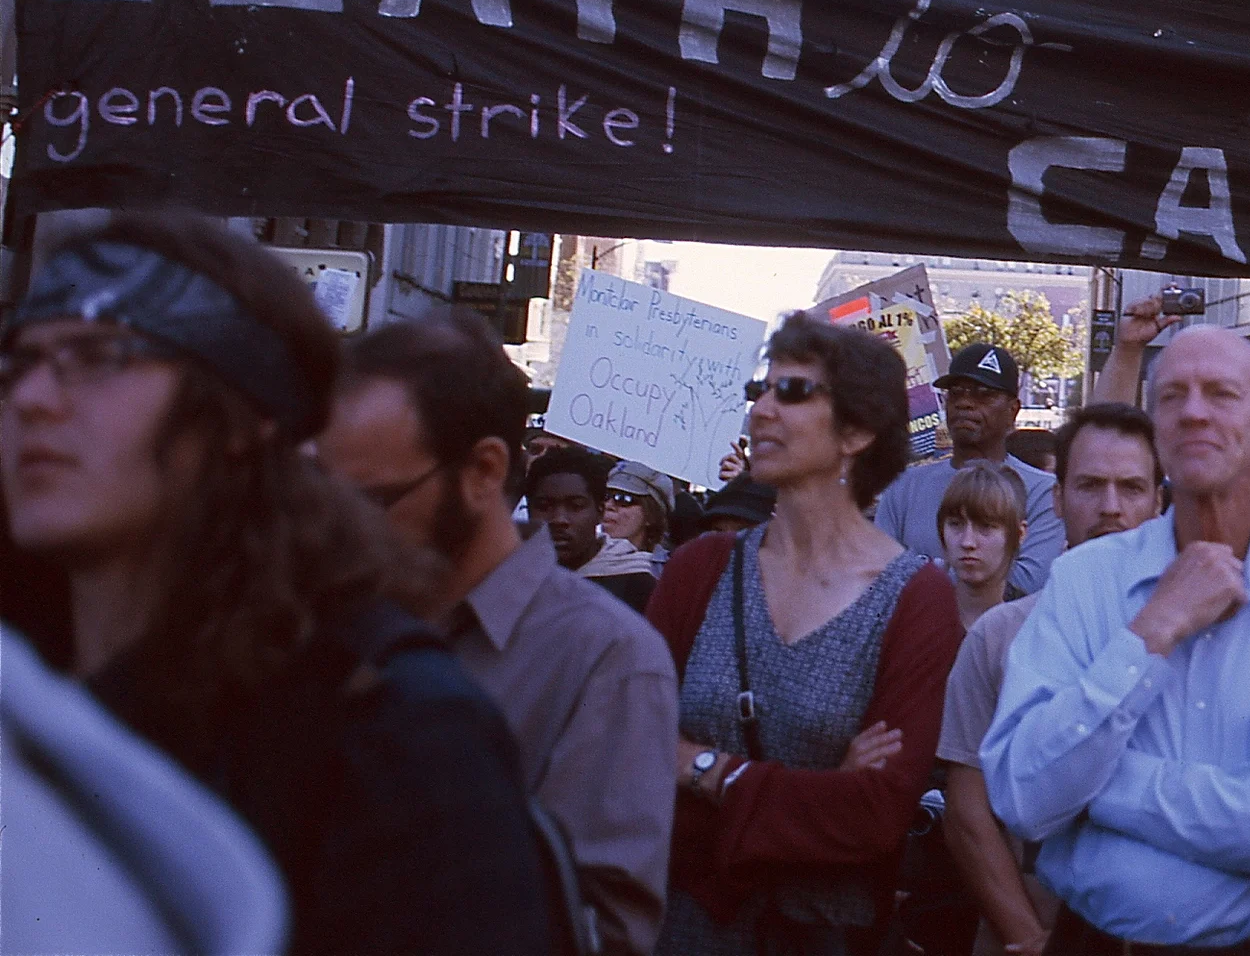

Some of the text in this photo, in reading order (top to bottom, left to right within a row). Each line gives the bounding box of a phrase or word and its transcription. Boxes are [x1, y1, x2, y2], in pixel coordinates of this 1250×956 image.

[43, 77, 677, 162] general strike!
[585, 323, 599, 339] in
[612, 325, 697, 381] solidarity
[589, 356, 676, 417] Occupy
[569, 394, 664, 448] Oakland
[908, 413, 940, 434] NCOS
